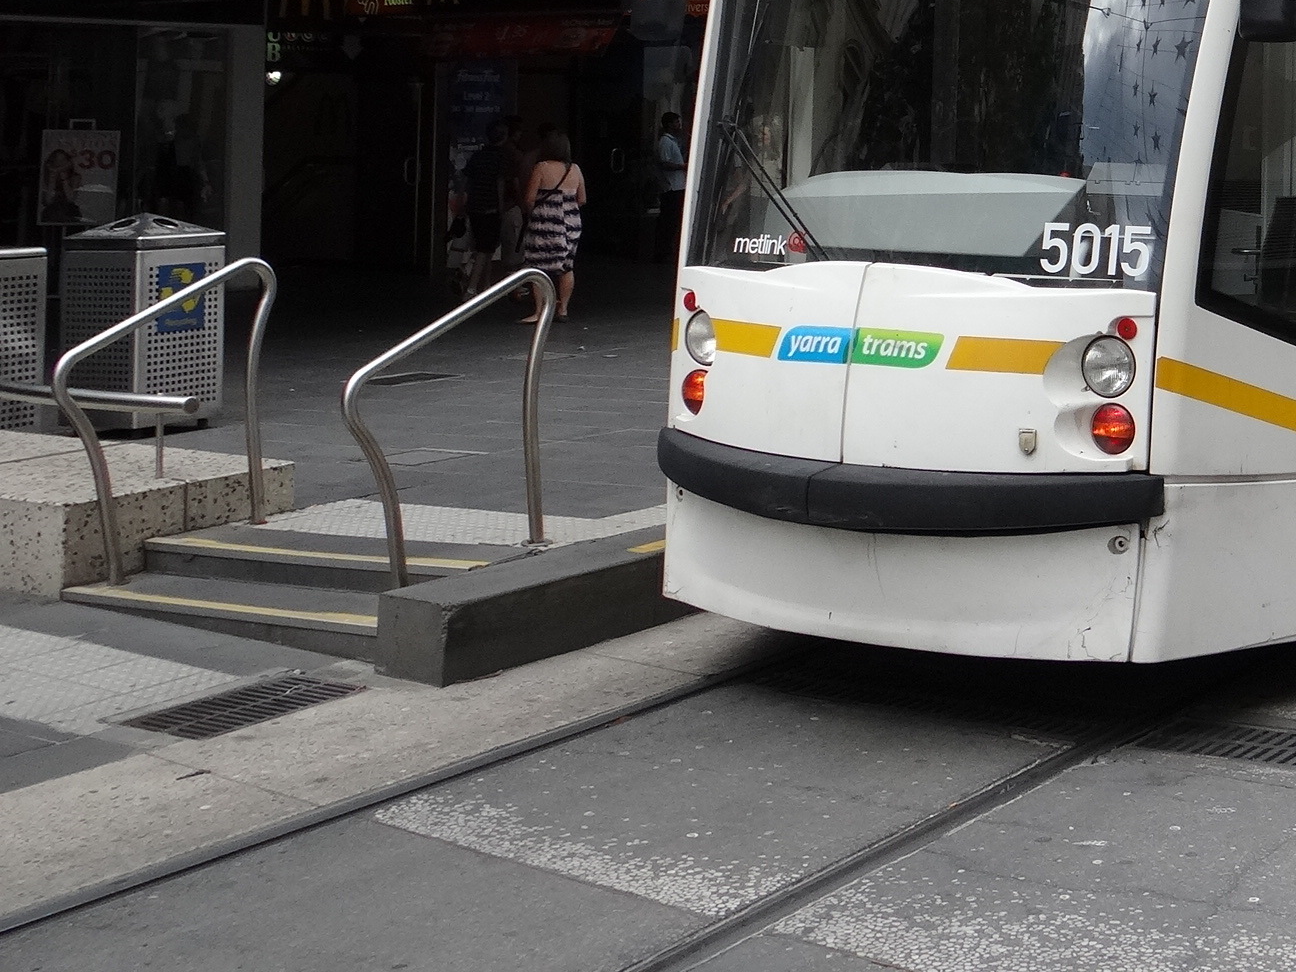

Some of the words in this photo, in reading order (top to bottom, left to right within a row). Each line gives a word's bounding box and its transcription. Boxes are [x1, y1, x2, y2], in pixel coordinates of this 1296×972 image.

[733, 233, 787, 256] metlink
[1039, 221, 1152, 278] 5015
[786, 330, 843, 357] yarra
[861, 333, 929, 360] trams
